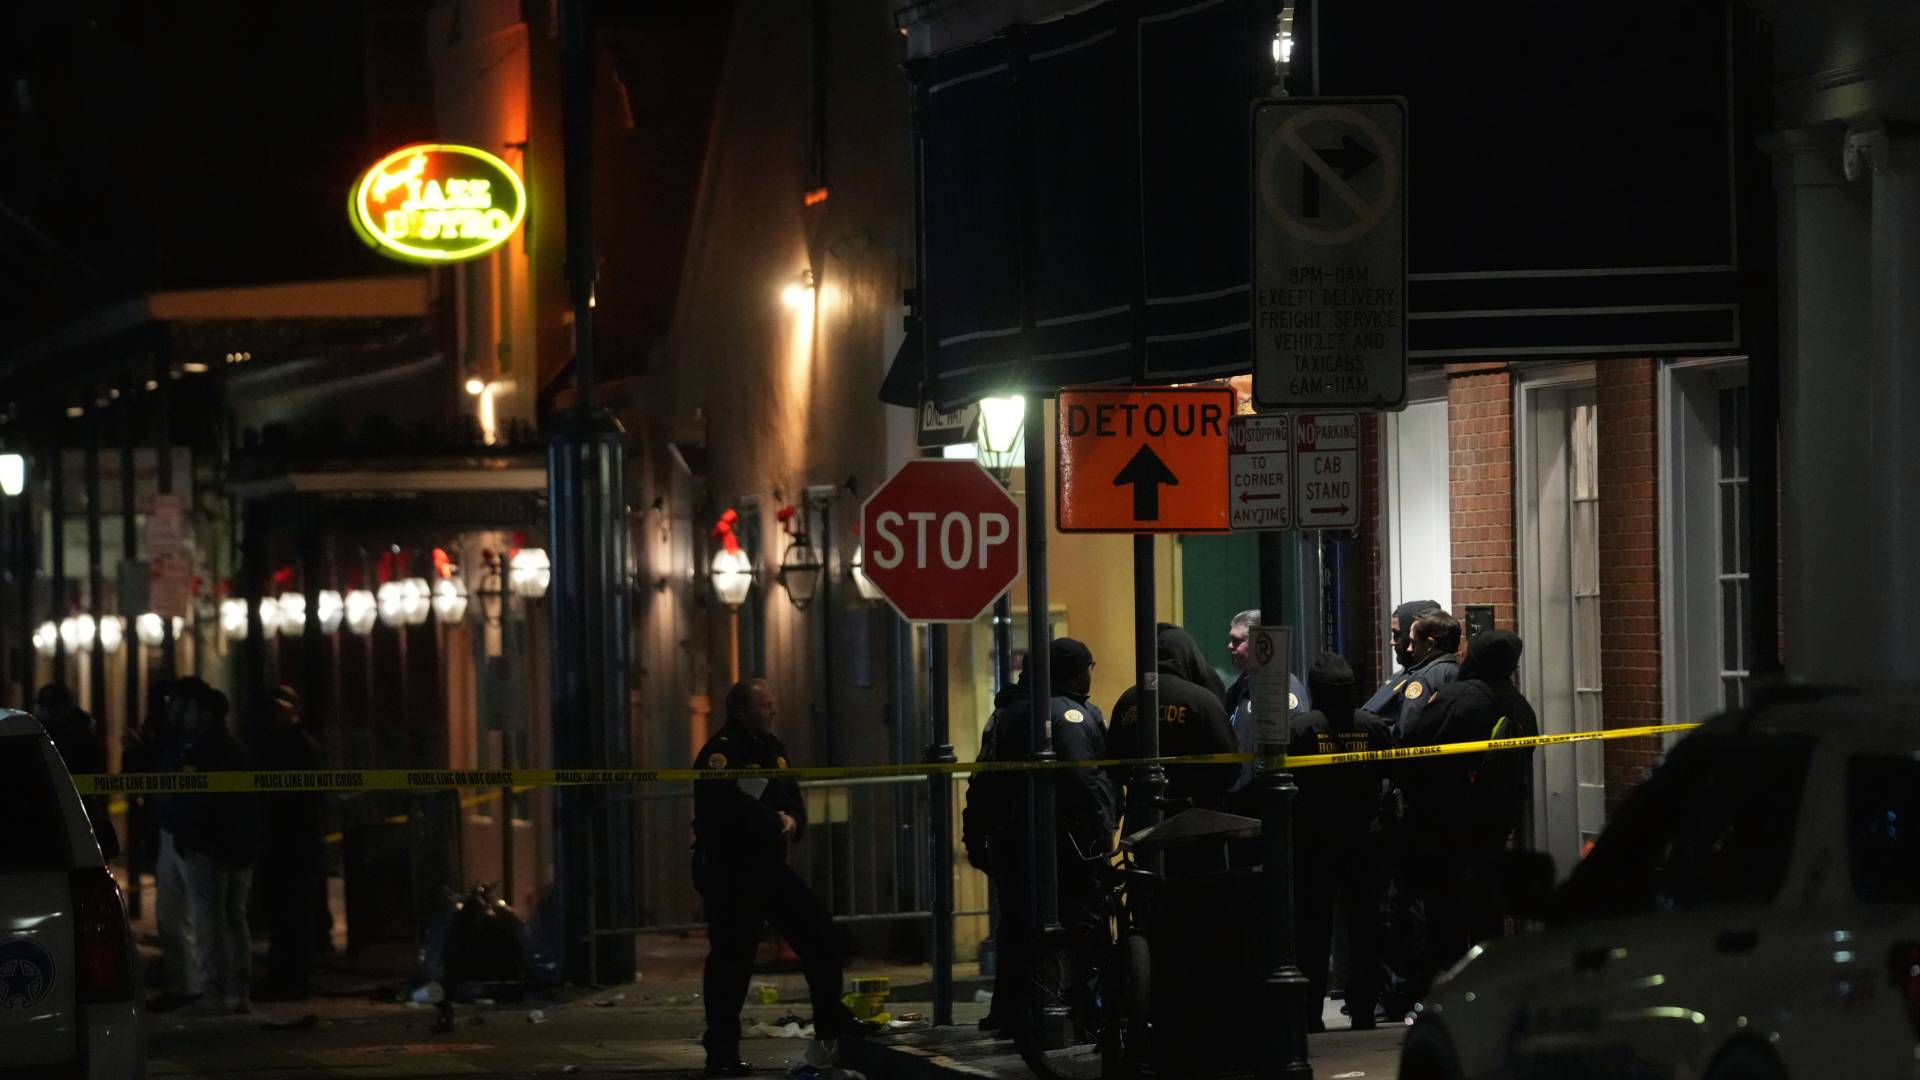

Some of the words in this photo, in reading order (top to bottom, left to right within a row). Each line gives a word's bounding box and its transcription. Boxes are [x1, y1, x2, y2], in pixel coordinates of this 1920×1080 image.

[1259, 288, 1315, 306] EXCEPT
[1335, 310, 1399, 328] SERVICE
[1274, 332, 1345, 350] VEHICLES
[1353, 332, 1384, 350] AND
[1294, 355, 1365, 372] TAXICABS
[1067, 402, 1223, 437] DETOUR
[1229, 423, 1246, 447] NO
[1246, 425, 1287, 442] STOPPING
[1297, 423, 1315, 445] NO
[1315, 424, 1357, 440] PARKING
[1251, 456, 1266, 469] TO
[1314, 456, 1342, 474] CAB
[1234, 473, 1284, 487] CORNER
[1306, 482, 1350, 500] STAND
[1234, 507, 1287, 522] ANYTIME
[873, 511, 1010, 570] STOP
[94, 775, 124, 791] POLICE
[126, 775, 144, 791] LINE
[146, 775, 158, 790] DO
[160, 775, 177, 790] NOT
[178, 774, 208, 789] CROSS
[254, 774, 282, 788] POLICE
[284, 774, 302, 788] LINE
[303, 774, 316, 787] DO
[317, 773, 334, 787] NOT
[335, 773, 363, 786] CROSS
[407, 772, 436, 786] POLICE
